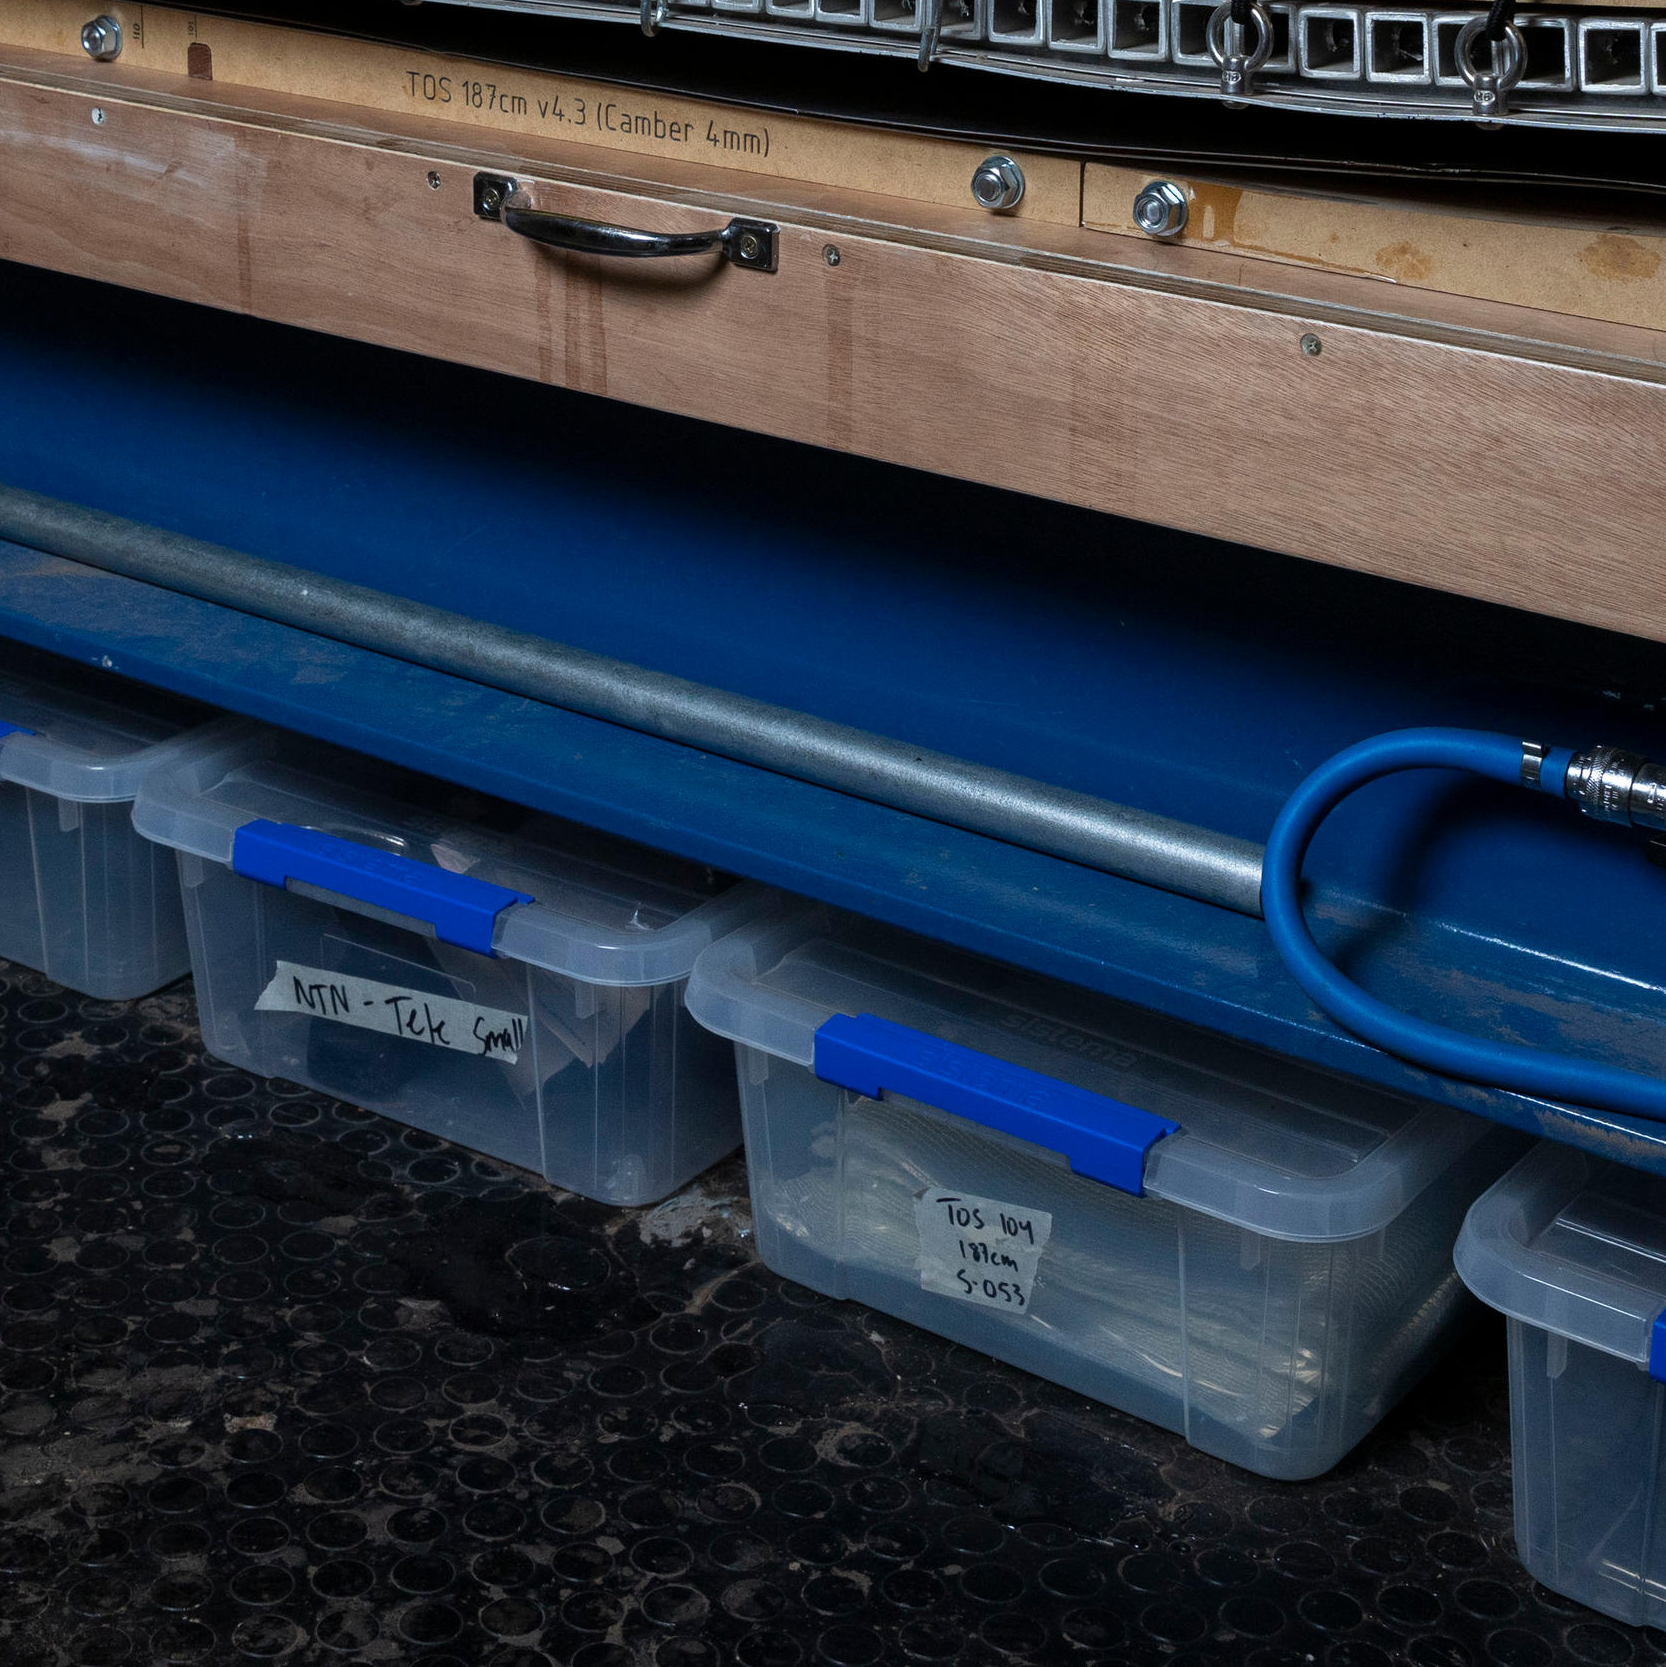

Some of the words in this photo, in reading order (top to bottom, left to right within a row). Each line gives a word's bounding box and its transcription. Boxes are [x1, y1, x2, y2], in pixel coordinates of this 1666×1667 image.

[406, 70, 453, 103] TOS
[461, 80, 528, 116] 187cm
[537, 95, 586, 126] v4.3
[596, 102, 695, 142] (Camber
[706, 120, 771, 158] 4mm)
[293, 976, 350, 1015] NTN
[473, 1016, 524, 1056] Small
[936, 1197, 985, 1230] TOS
[958, 1240, 1019, 1273] 187cm
